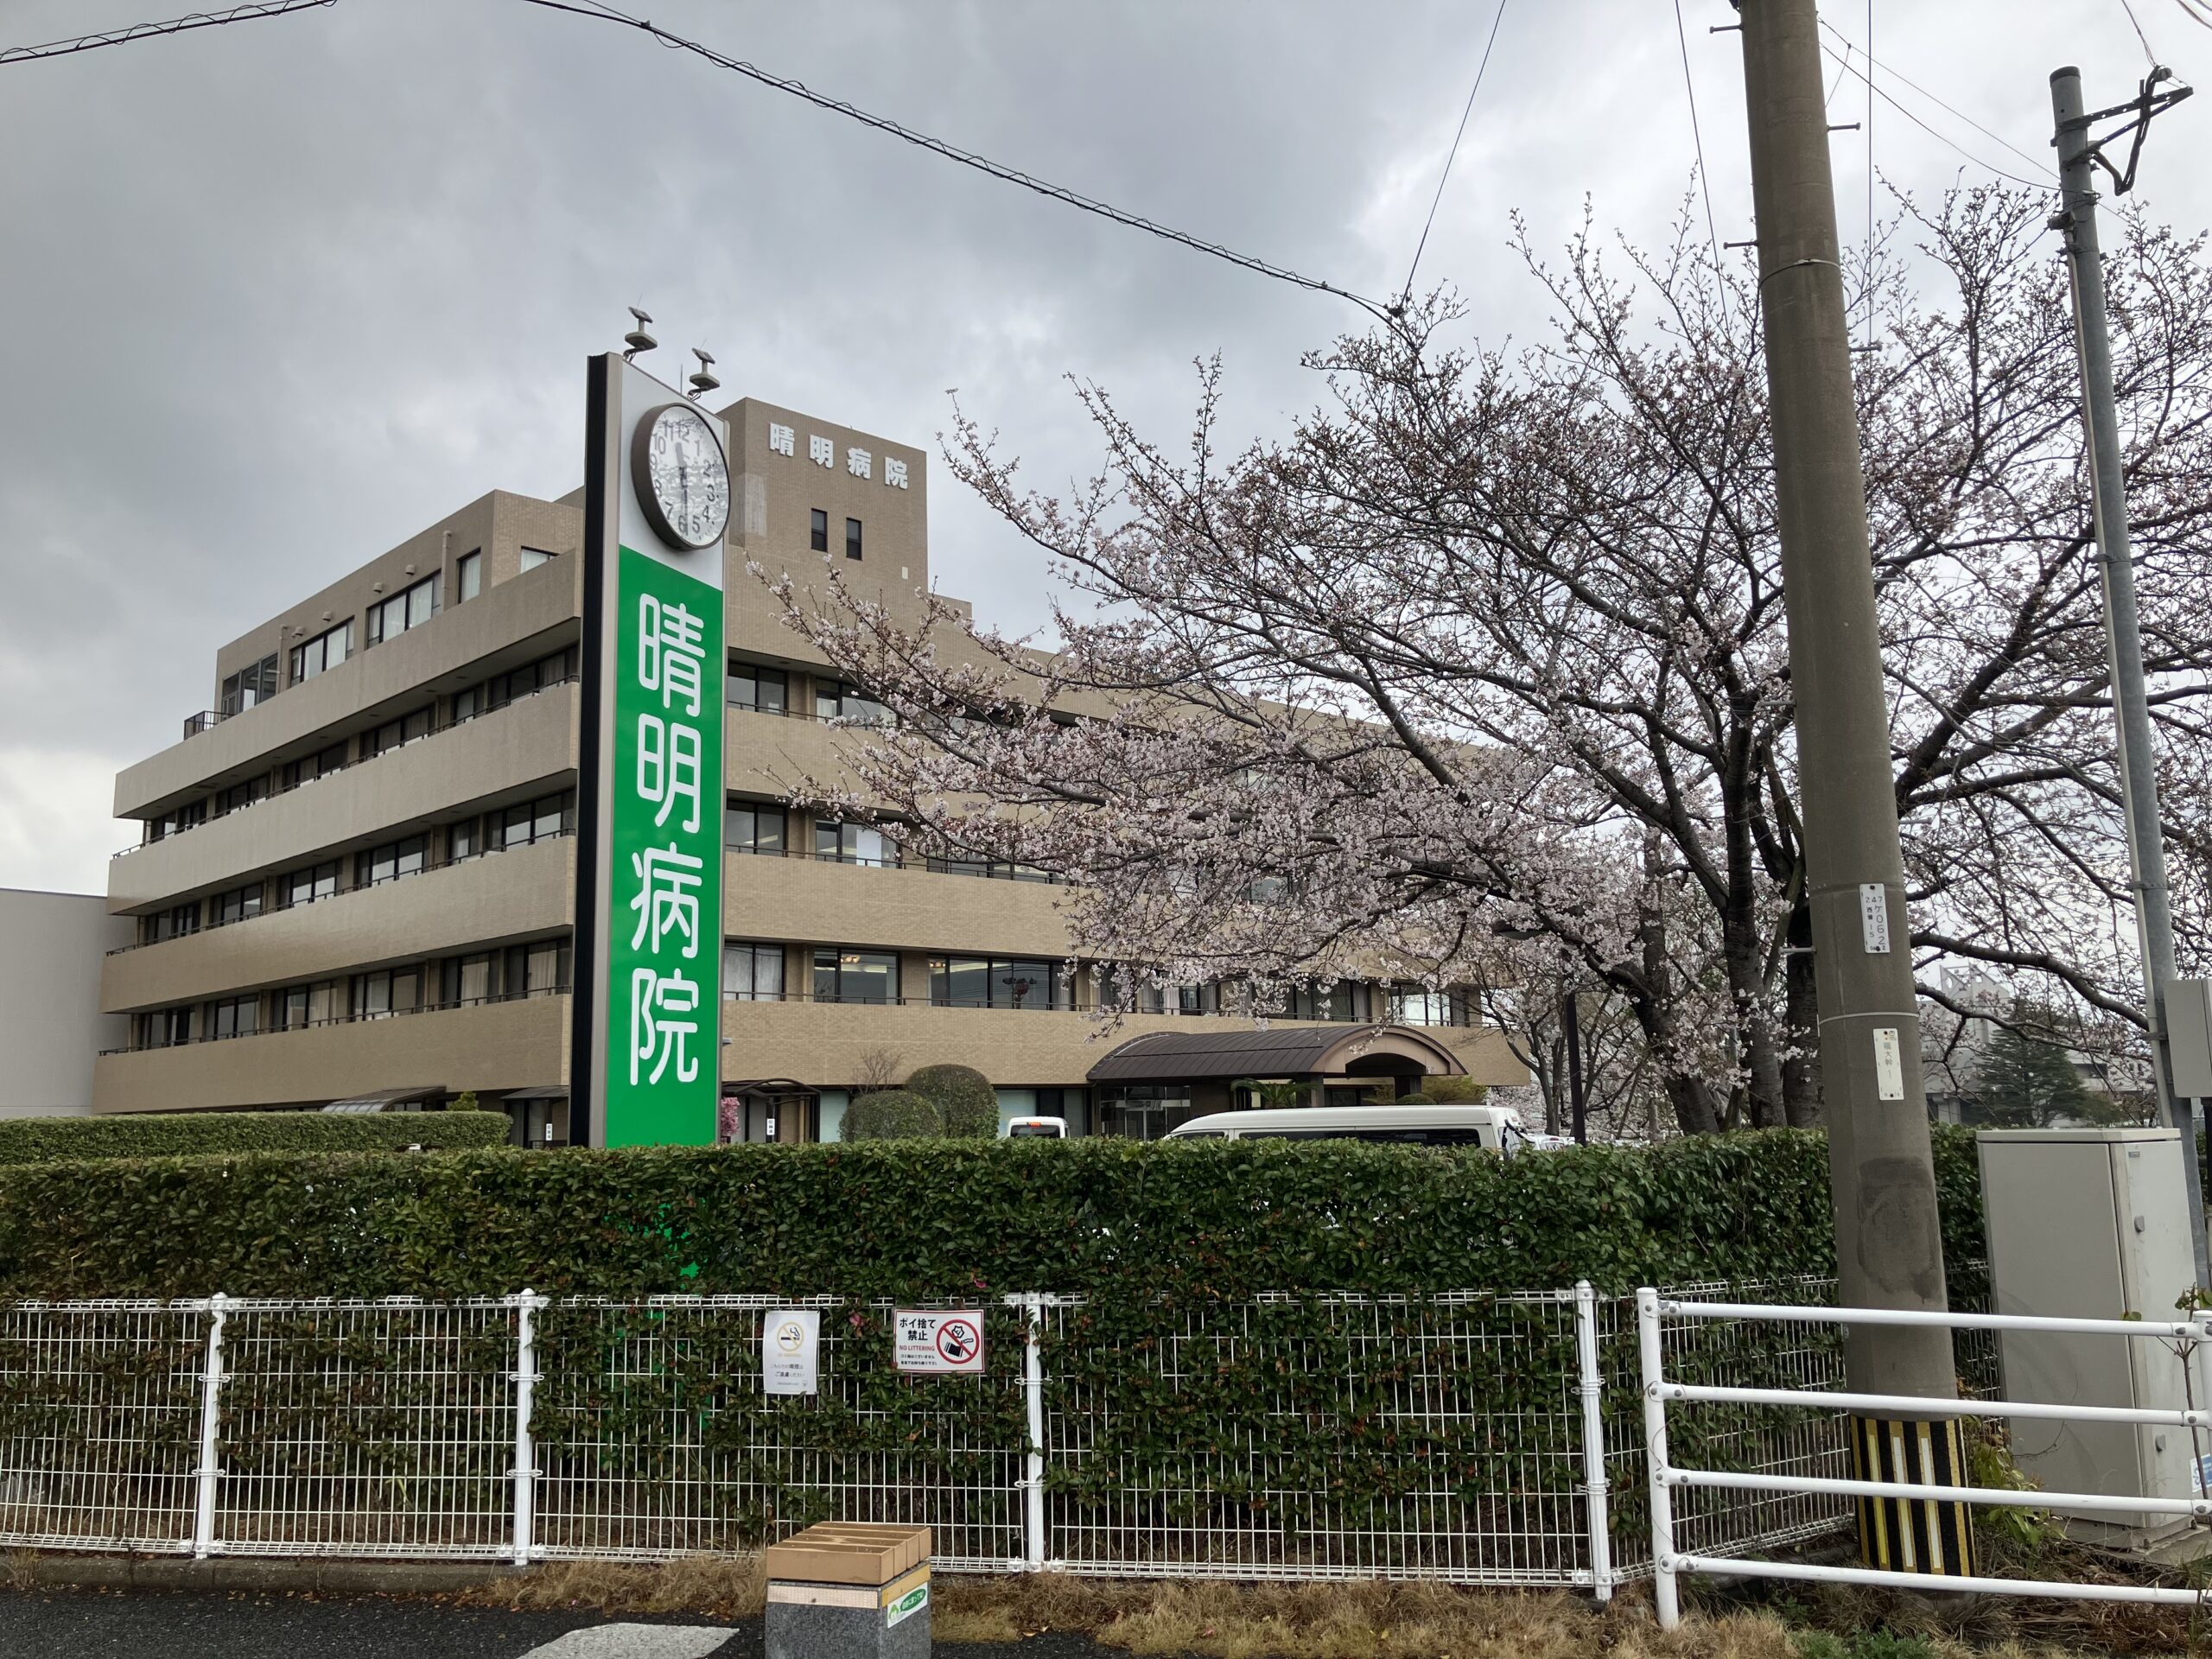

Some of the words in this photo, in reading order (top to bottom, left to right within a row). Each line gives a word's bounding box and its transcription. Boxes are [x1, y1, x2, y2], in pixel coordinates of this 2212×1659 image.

[663, 420, 673, 442] 11
[677, 421, 690, 442] 12
[652, 432, 666, 454] 10
[694, 439, 700, 457] 1
[650, 453, 657, 472] 9
[769, 422, 908, 490] 晴明病院
[703, 459, 711, 478] 2
[654, 479, 662, 498] 8
[707, 484, 715, 501] 3
[664, 501, 673, 519] 7
[702, 505, 710, 523] 4
[678, 515, 687, 534] 6
[692, 515, 700, 534] 5
[630, 593, 706, 1086] 晴明病院
[899, 1318, 936, 1329] ポイ捨て
[907, 1330, 928, 1340] 禁止
